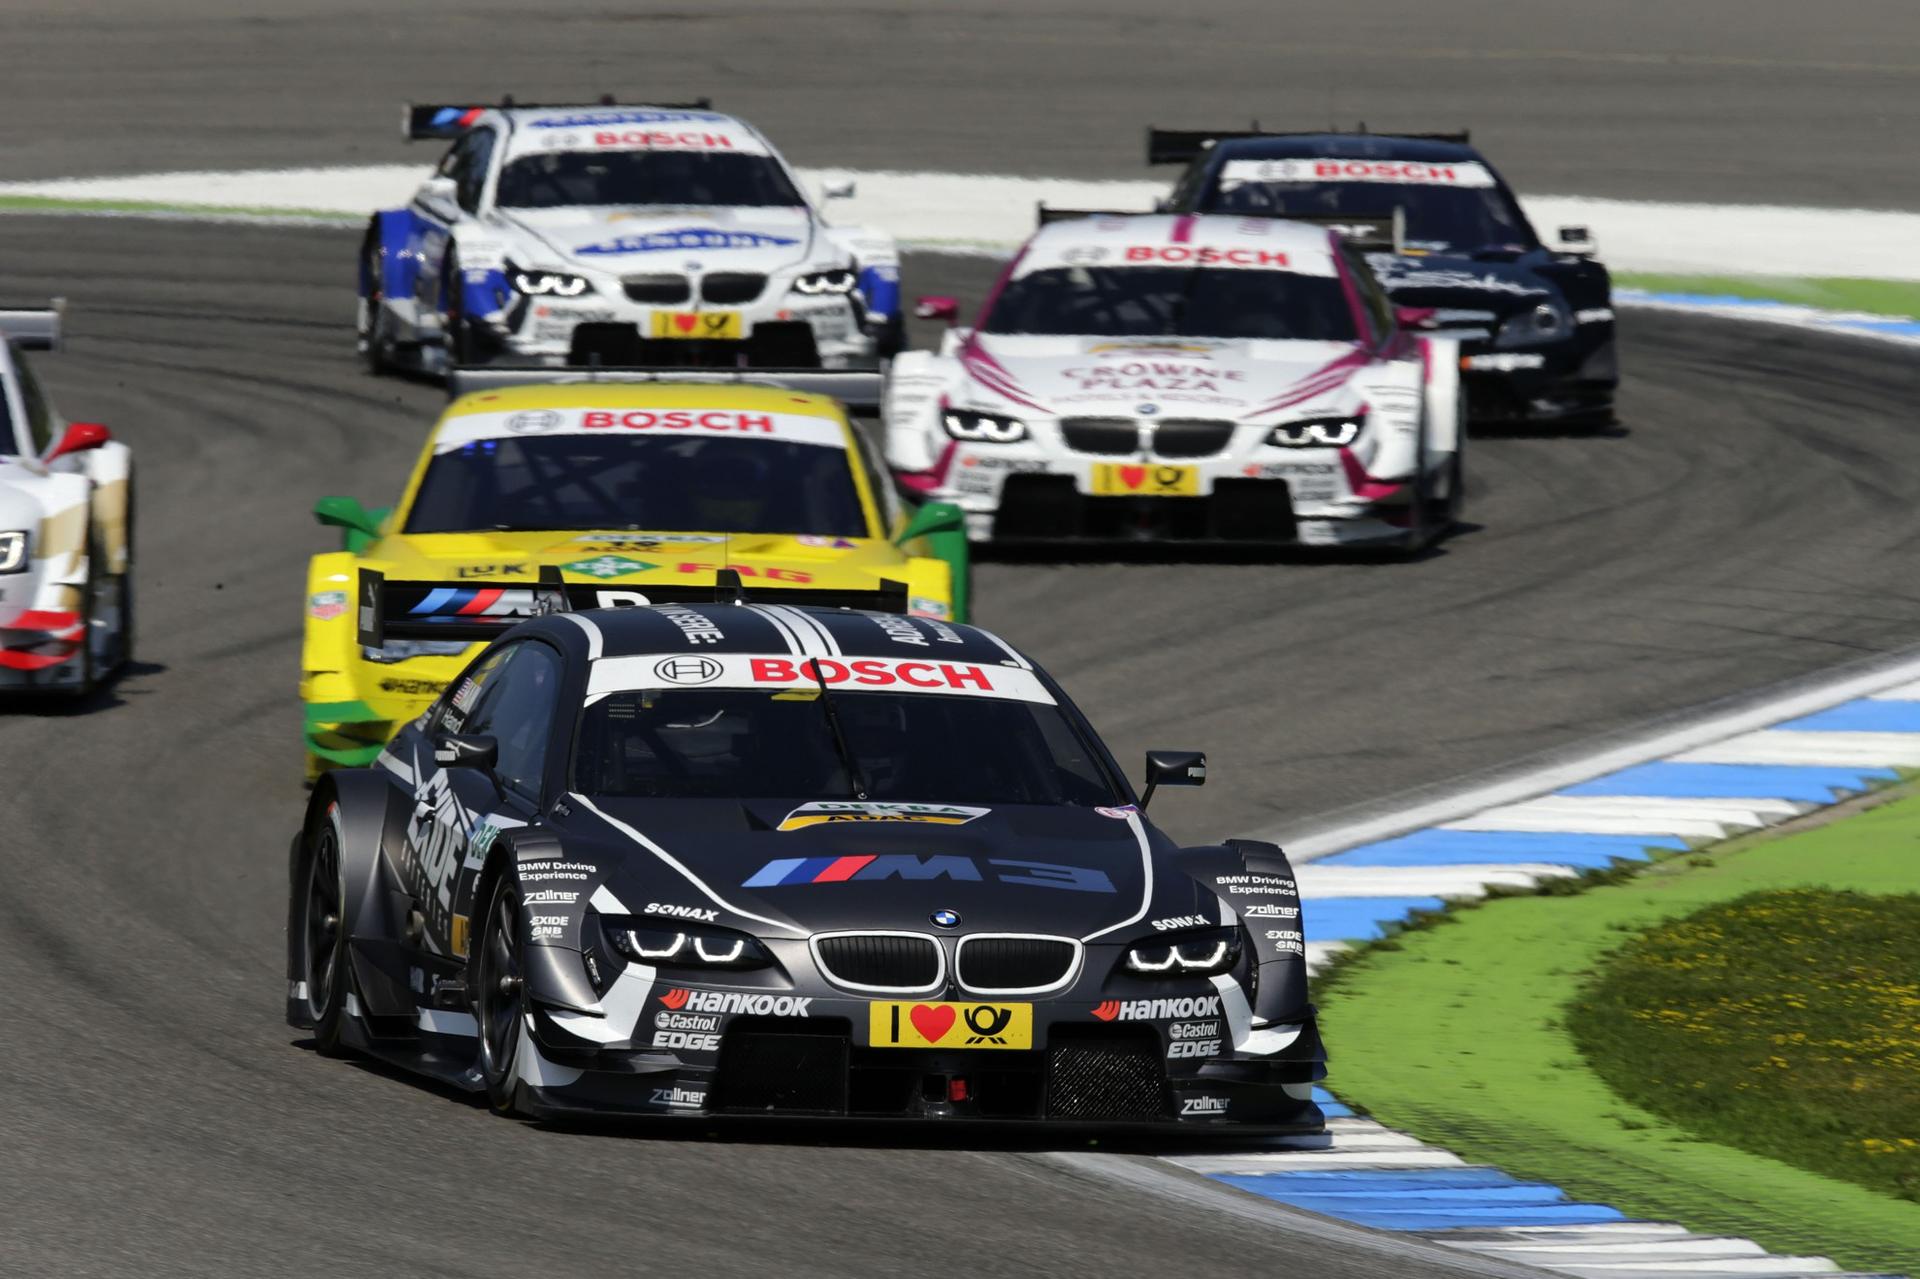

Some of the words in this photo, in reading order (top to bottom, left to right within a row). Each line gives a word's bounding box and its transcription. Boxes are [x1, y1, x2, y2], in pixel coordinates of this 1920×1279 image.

[594, 131, 732, 148] BOSCH
[1314, 161, 1456, 181] BOSCH
[1125, 246, 1290, 267] BOSCH
[1061, 363, 1247, 382] CROWNE
[1081, 378, 1219, 392] PLAZA
[582, 411, 774, 433] BOSCH
[750, 657, 994, 691] BOSCH
[819, 802, 967, 814] DEKRA
[827, 814, 928, 822] ADAC
[517, 862, 551, 872] BMW
[553, 861, 597, 873] Driving
[519, 871, 588, 882] Experience
[1216, 876, 1249, 885] BMW
[1252, 876, 1295, 889] Driving
[1229, 886, 1297, 897] Experience
[644, 902, 720, 922] SONAX
[529, 915, 570, 927] EXIDE
[1152, 914, 1212, 932] SONAX
[531, 926, 562, 936] GNB
[1265, 930, 1303, 942] EXIDE
[668, 1014, 717, 1032] Castrol
[1182, 1021, 1218, 1039] Castrol
[652, 1031, 723, 1051] EDGE
[1167, 1039, 1222, 1059] EDGE
